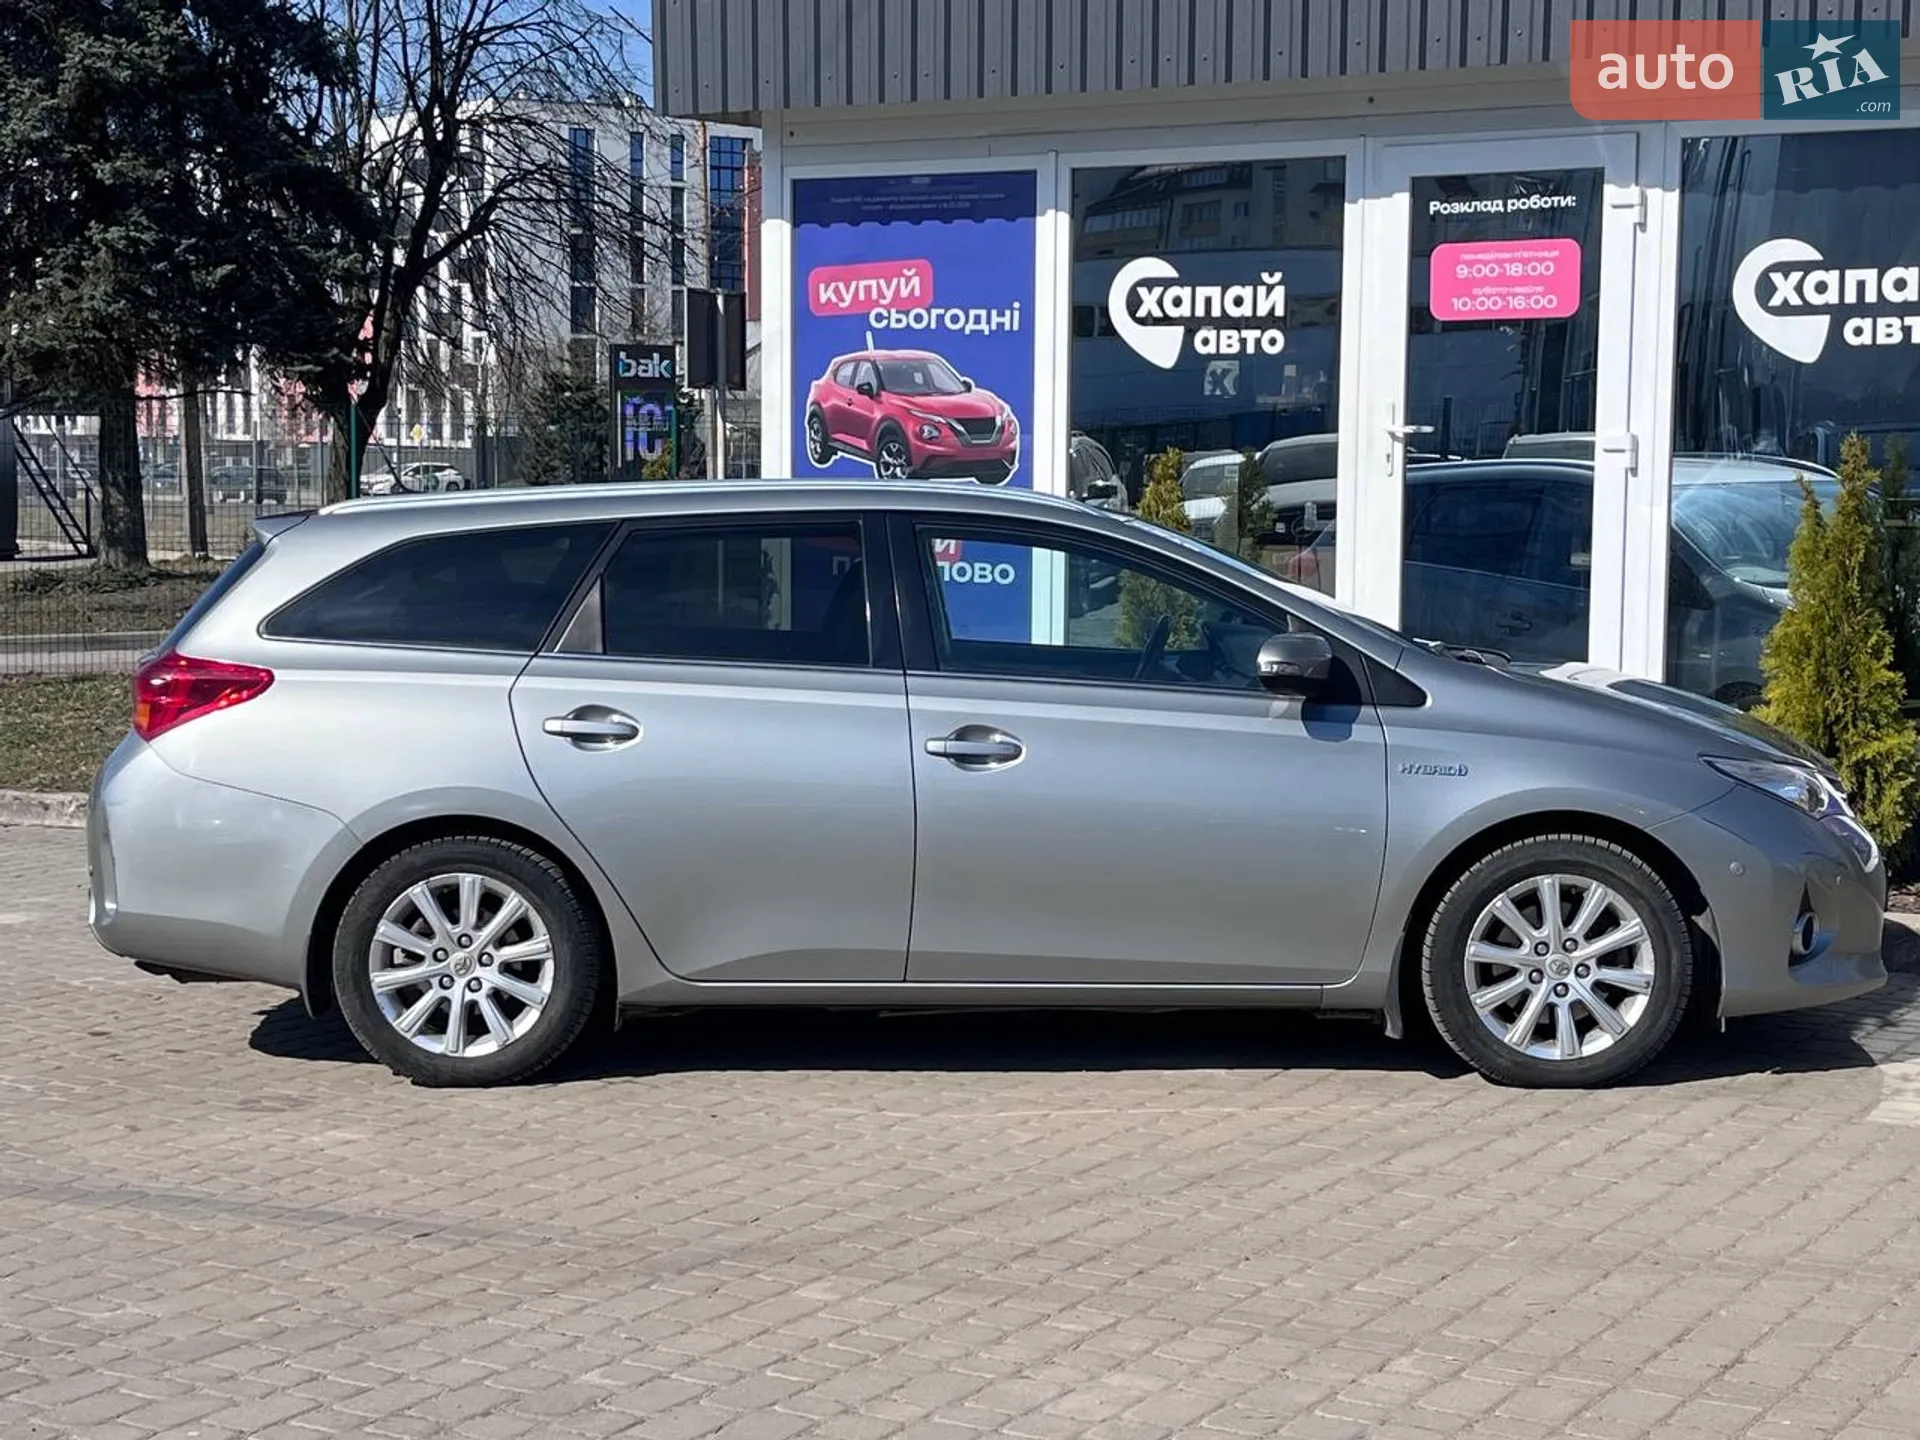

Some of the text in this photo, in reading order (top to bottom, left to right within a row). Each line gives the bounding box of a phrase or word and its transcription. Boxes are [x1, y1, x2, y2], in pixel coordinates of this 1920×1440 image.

[1429, 194, 1577, 215] Розклад роботи:
[1455, 261, 1555, 279] 9:00-18:00
[818, 268, 921, 309] купуй
[1451, 294, 1557, 311] 10:00-16:00
[868, 301, 1021, 336] сьогодні
[1843, 315, 1920, 347] авт
[1193, 328, 1285, 355] авто
[619, 351, 673, 378] bak
